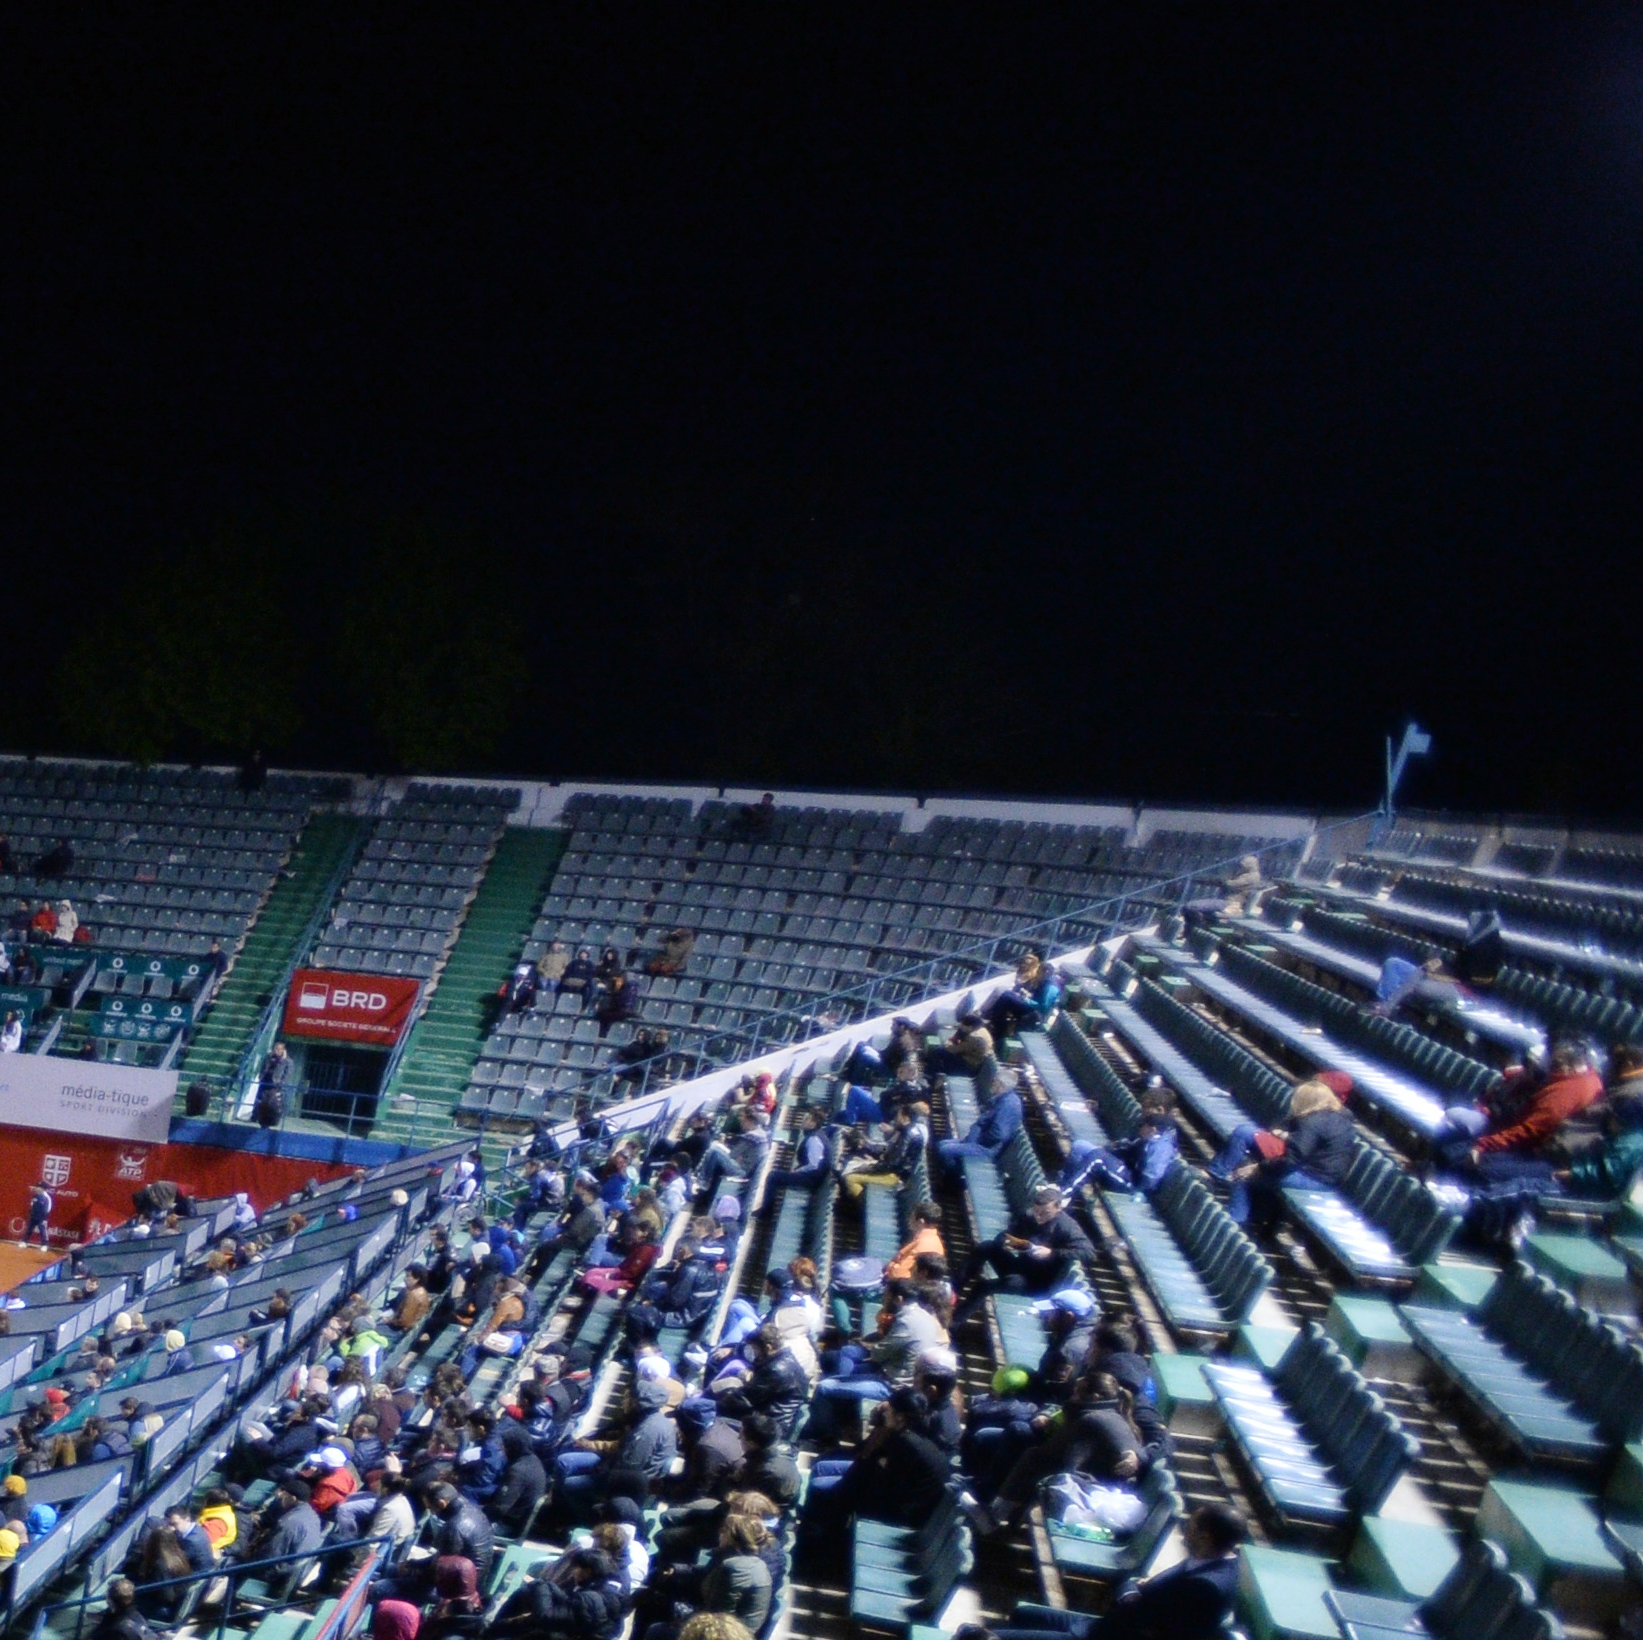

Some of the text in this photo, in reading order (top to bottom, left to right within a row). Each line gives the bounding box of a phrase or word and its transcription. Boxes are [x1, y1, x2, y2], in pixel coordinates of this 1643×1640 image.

[331, 989, 388, 1011] BRD
[296, 1016, 327, 1027] GROUPE
[327, 1019, 359, 1030] SOCIETE
[61, 1082, 150, 1108] média-tique
[60, 1100, 94, 1113] SPORT
[117, 1167, 143, 1177] ATP
[56, 1189, 79, 1198] AUTO
